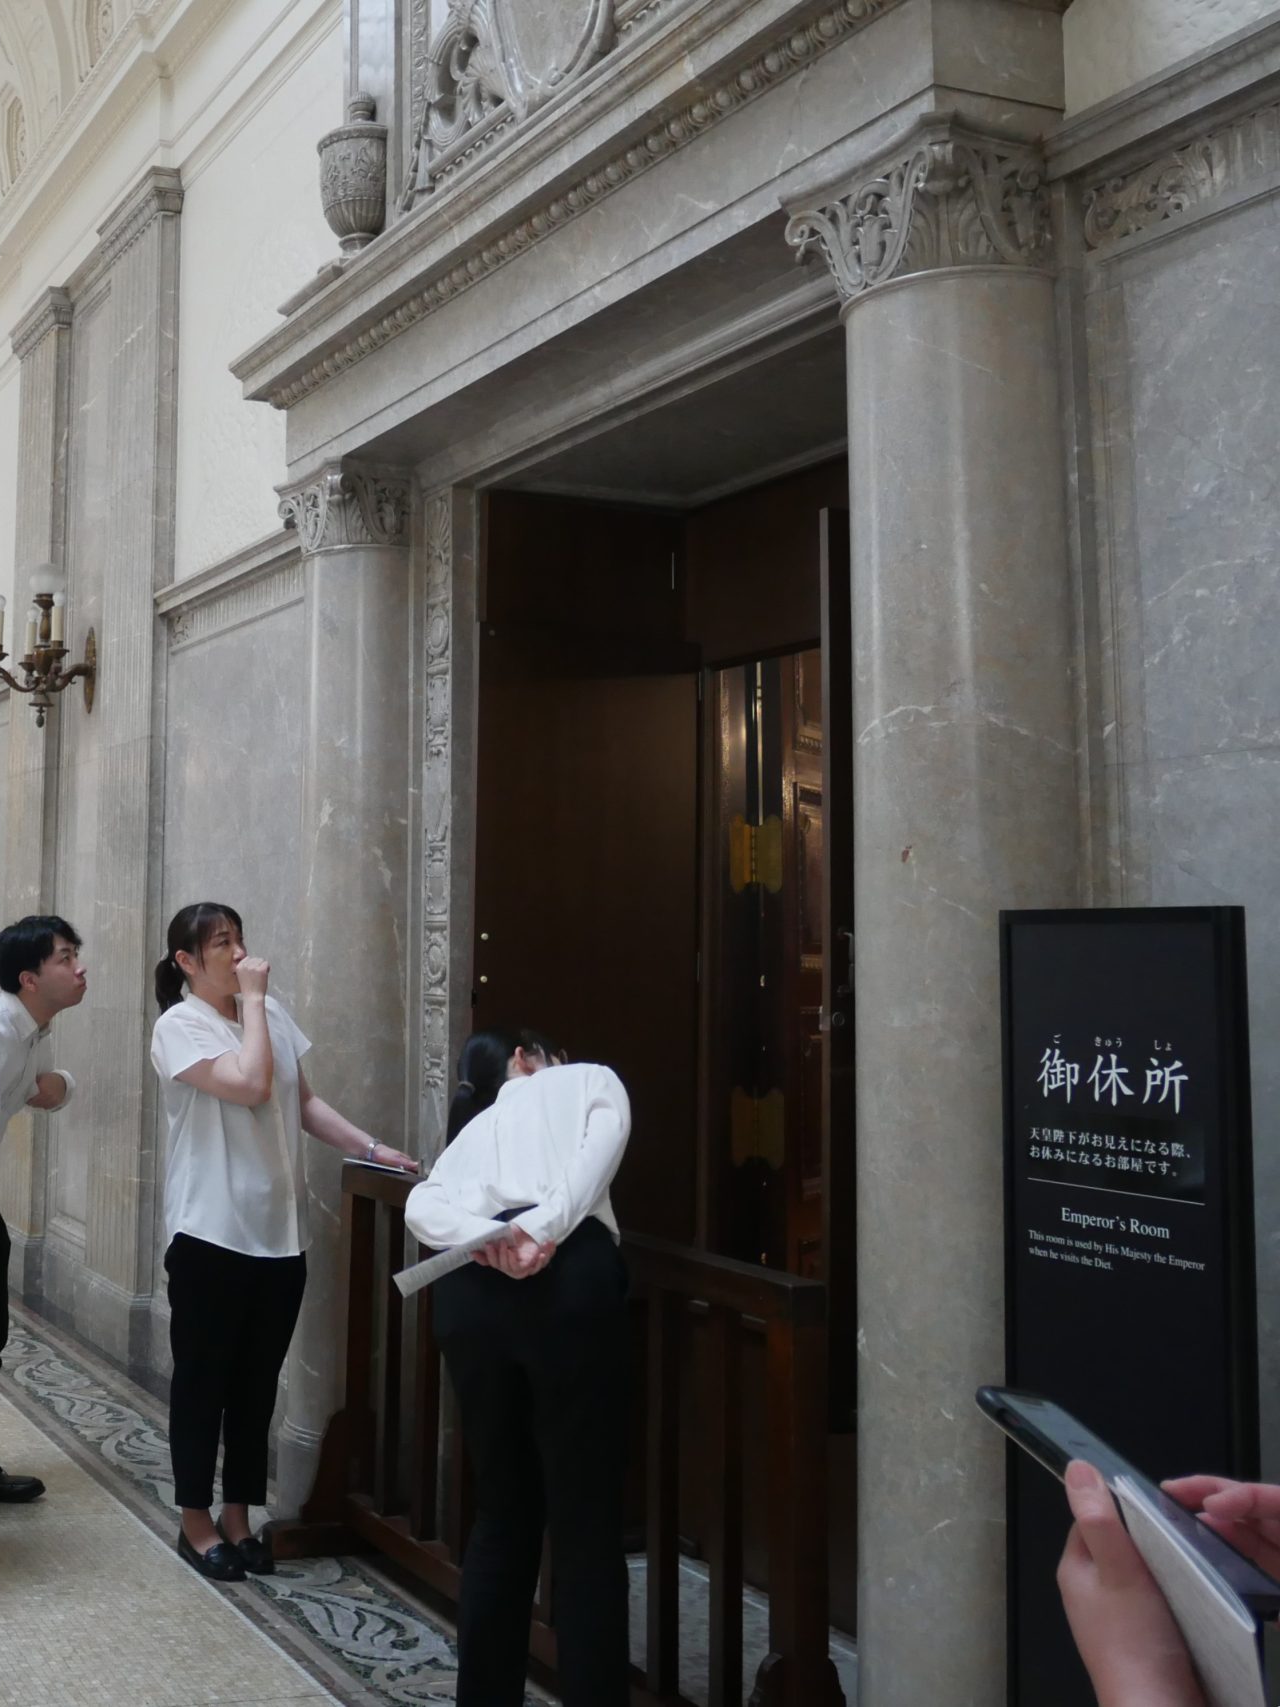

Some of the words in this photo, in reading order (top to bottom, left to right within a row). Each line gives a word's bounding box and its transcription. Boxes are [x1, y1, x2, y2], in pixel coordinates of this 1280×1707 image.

[1036, 1047, 1189, 1115] 御休所
[1029, 1127, 1191, 1159] 天皇陛下がお見えになる際、
[1029, 1145, 1178, 1177] お休みになるお部屋です。
[1129, 1218, 1170, 1239] Room
[1028, 1229, 1045, 1241] This
[1046, 1234, 1065, 1245] room
[1067, 1237, 1073, 1246] is
[1075, 1238, 1092, 1250] used
[1093, 1241, 1103, 1254] by
[1105, 1243, 1119, 1255] His
[1121, 1247, 1152, 1263] Majesty
[1154, 1252, 1167, 1264] the
[1169, 1255, 1205, 1271] Emperor
[1028, 1246, 1048, 1258] when
[1049, 1249, 1059, 1260] he
[1060, 1252, 1080, 1263] visits
[1081, 1255, 1093, 1266] the
[1094, 1257, 1114, 1270] Diet.
